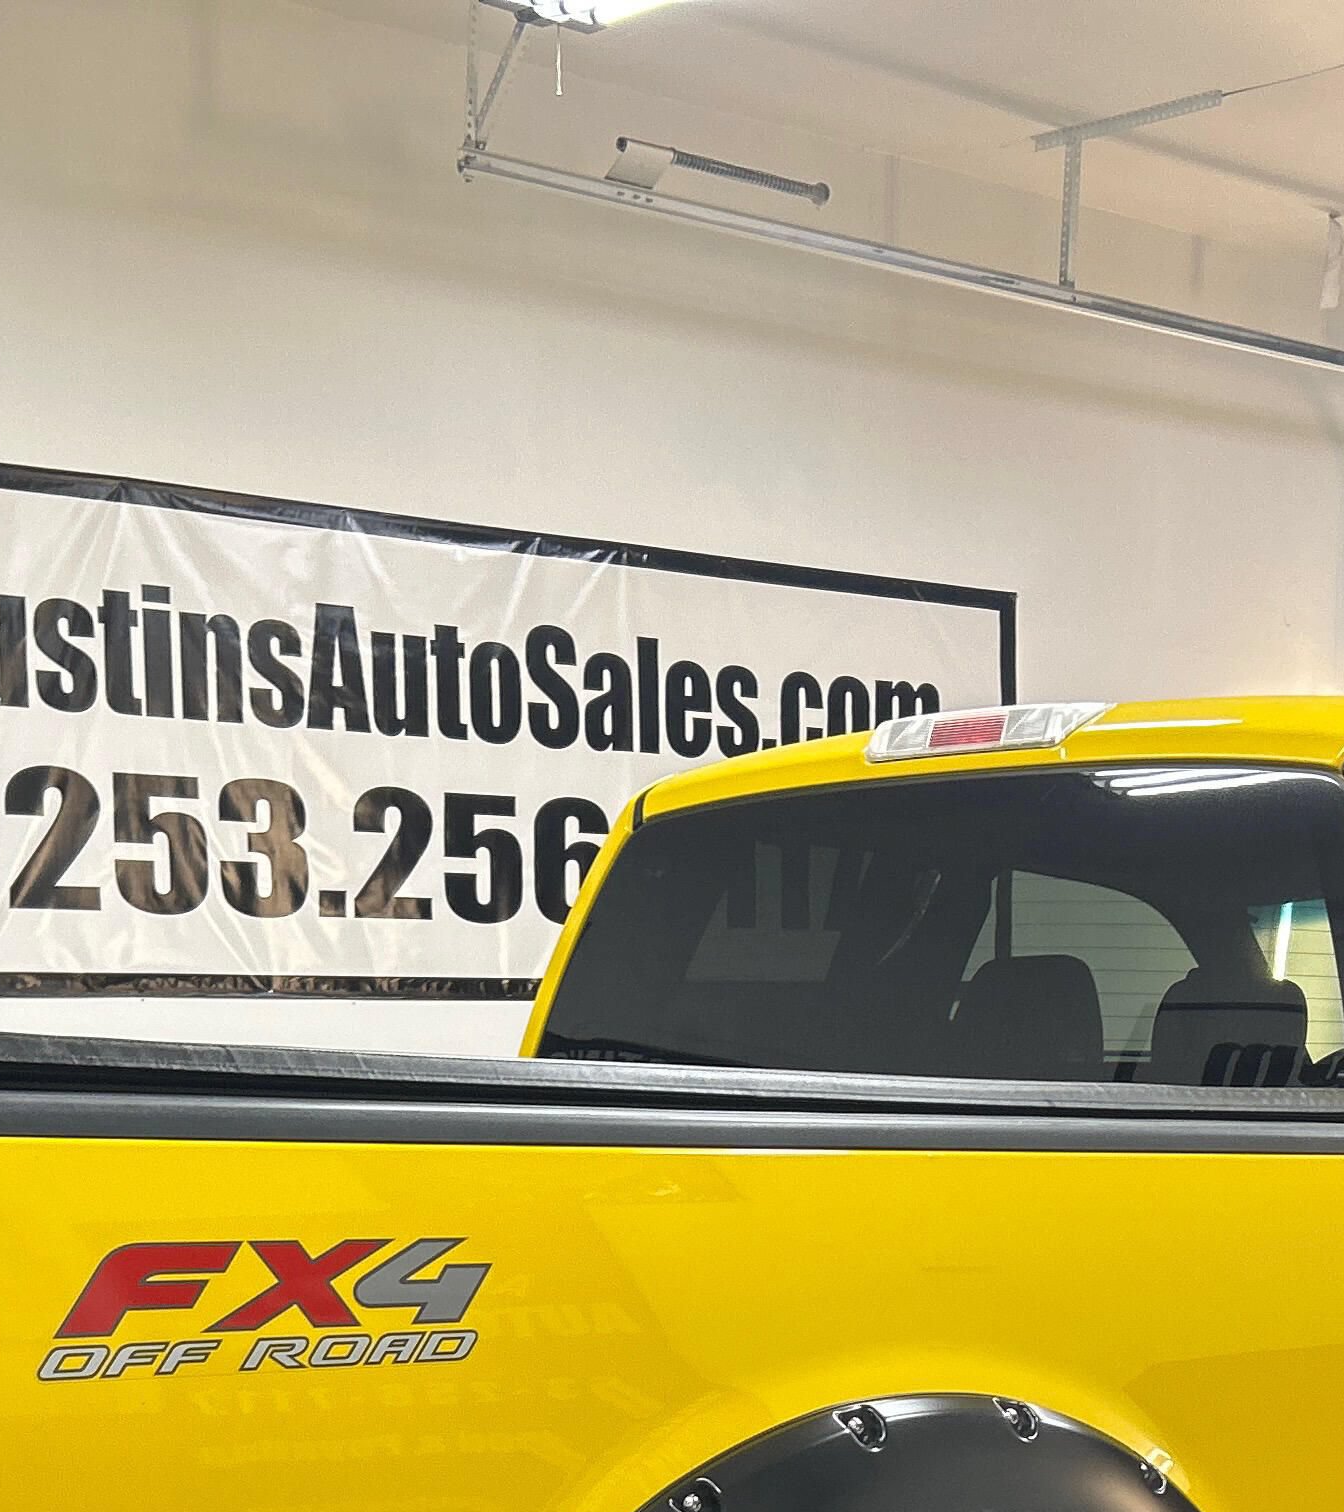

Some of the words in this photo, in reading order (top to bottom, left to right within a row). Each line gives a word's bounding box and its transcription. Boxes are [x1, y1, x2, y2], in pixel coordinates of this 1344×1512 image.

[4, 764, 609, 925] 253.256
[53, 1237, 492, 1339] FX4
[37, 1339, 223, 1381] OFF
[239, 1329, 479, 1372] ROAD
